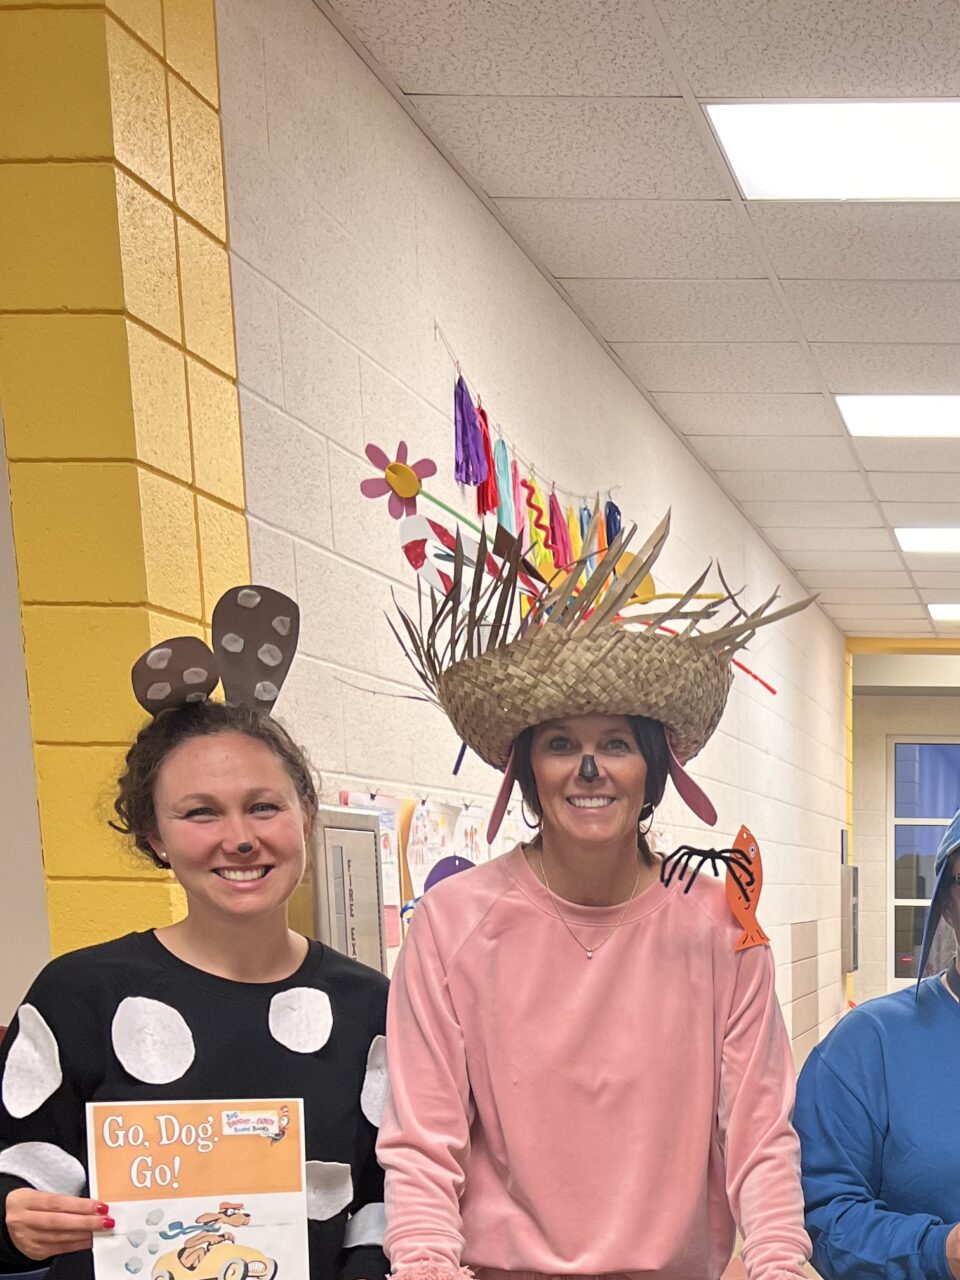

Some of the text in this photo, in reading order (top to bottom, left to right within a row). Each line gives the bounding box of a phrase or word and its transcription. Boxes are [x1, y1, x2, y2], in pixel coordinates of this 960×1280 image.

[347, 859, 355, 918] FIRE
[102, 1113, 220, 1153] Go, Dog.
[130, 1154, 182, 1189] Go!
